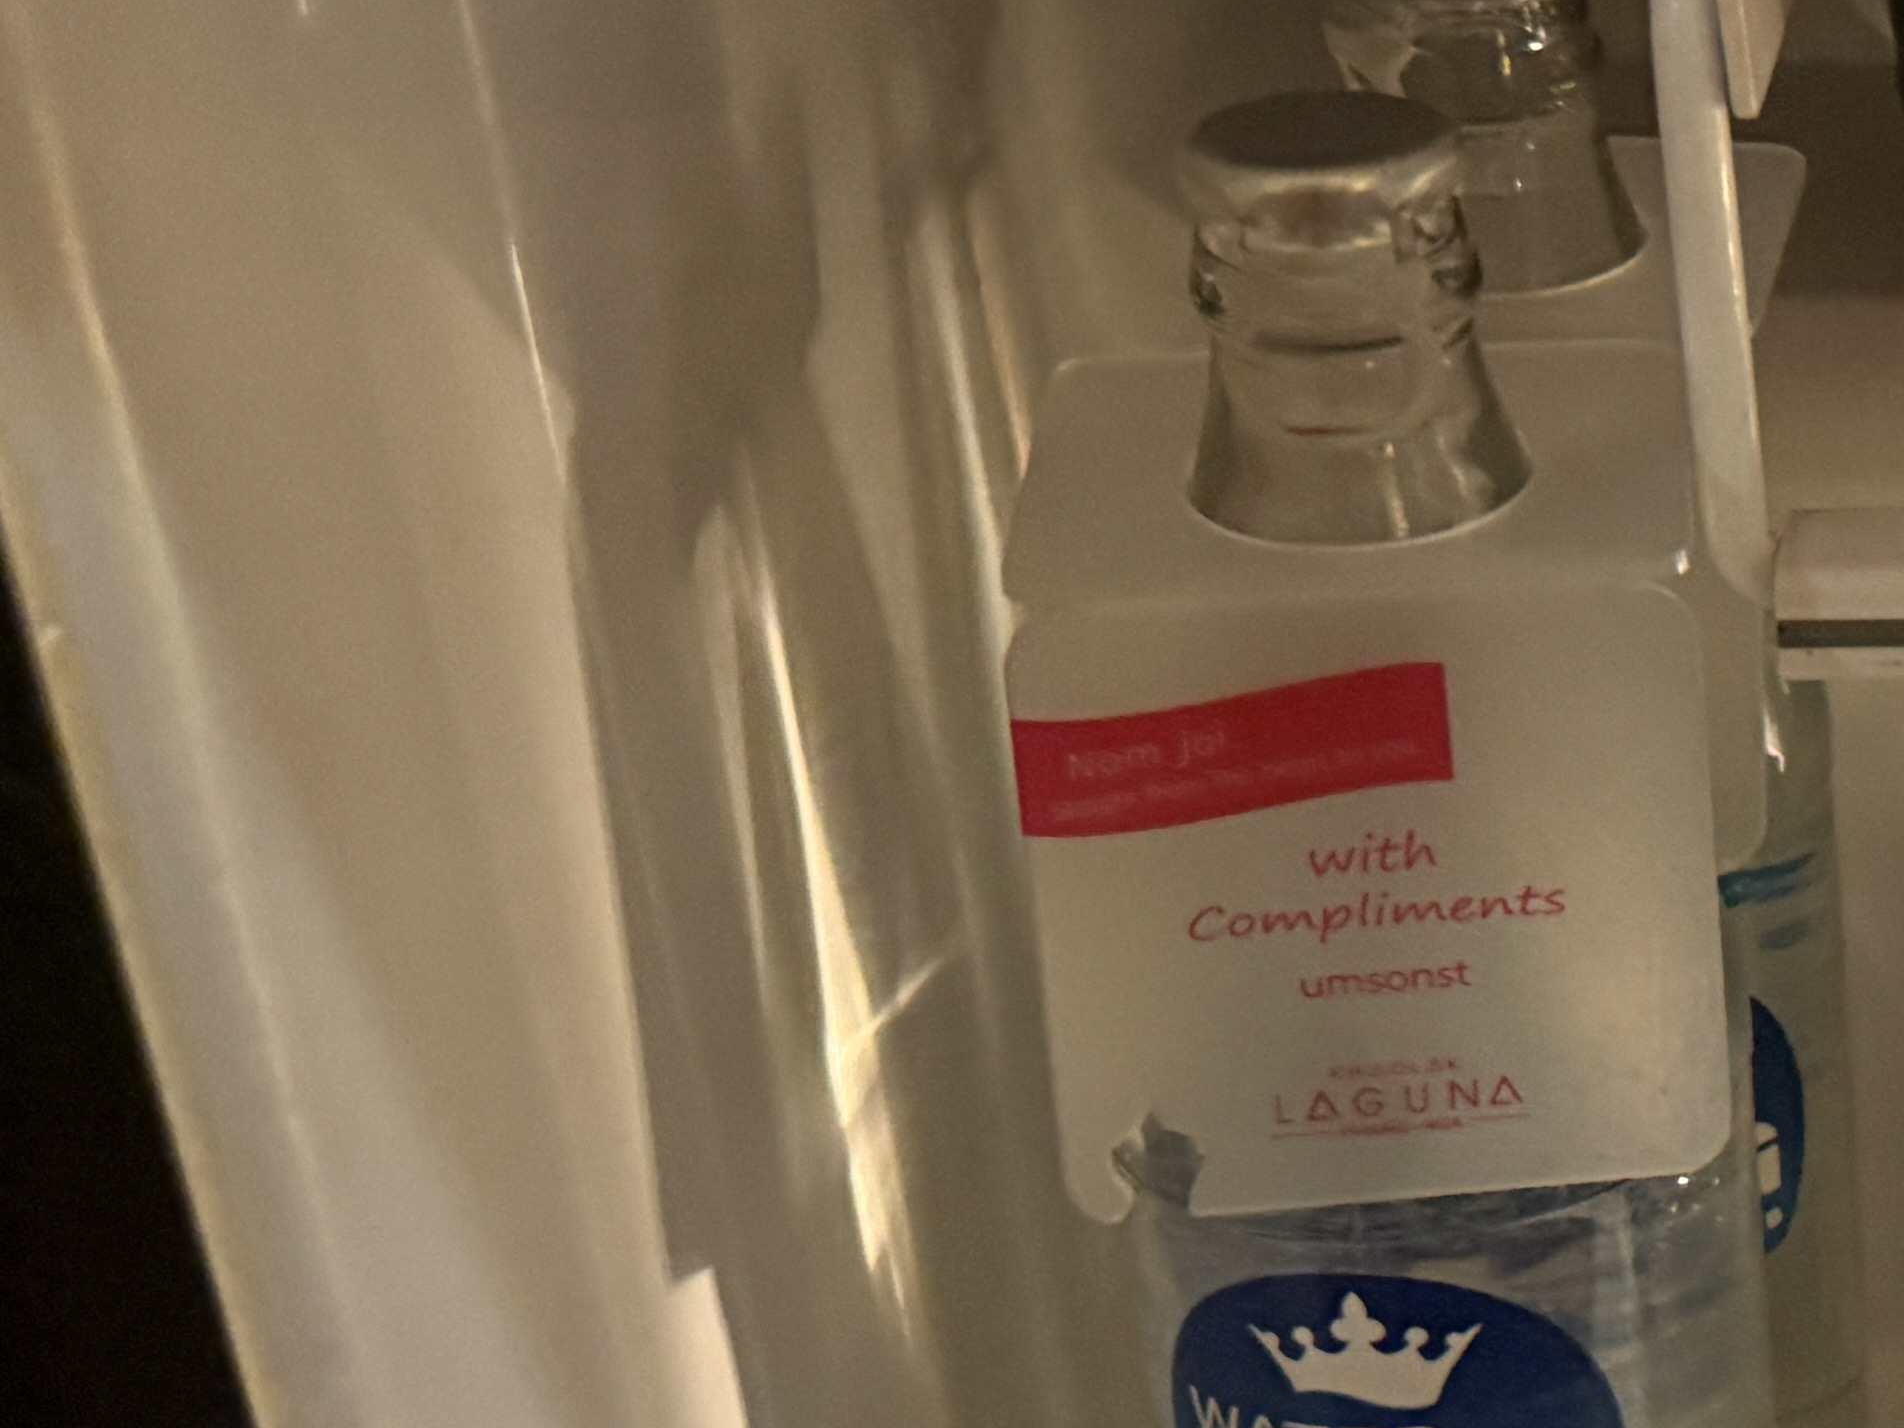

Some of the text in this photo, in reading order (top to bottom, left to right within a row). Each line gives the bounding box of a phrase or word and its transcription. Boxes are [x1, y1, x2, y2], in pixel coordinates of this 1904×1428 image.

[1309, 830, 1437, 878] with
[1188, 883, 1566, 943] Compliments
[1300, 962, 1472, 1000] umsonst
[1272, 1075, 1523, 1125] LAGUNA
